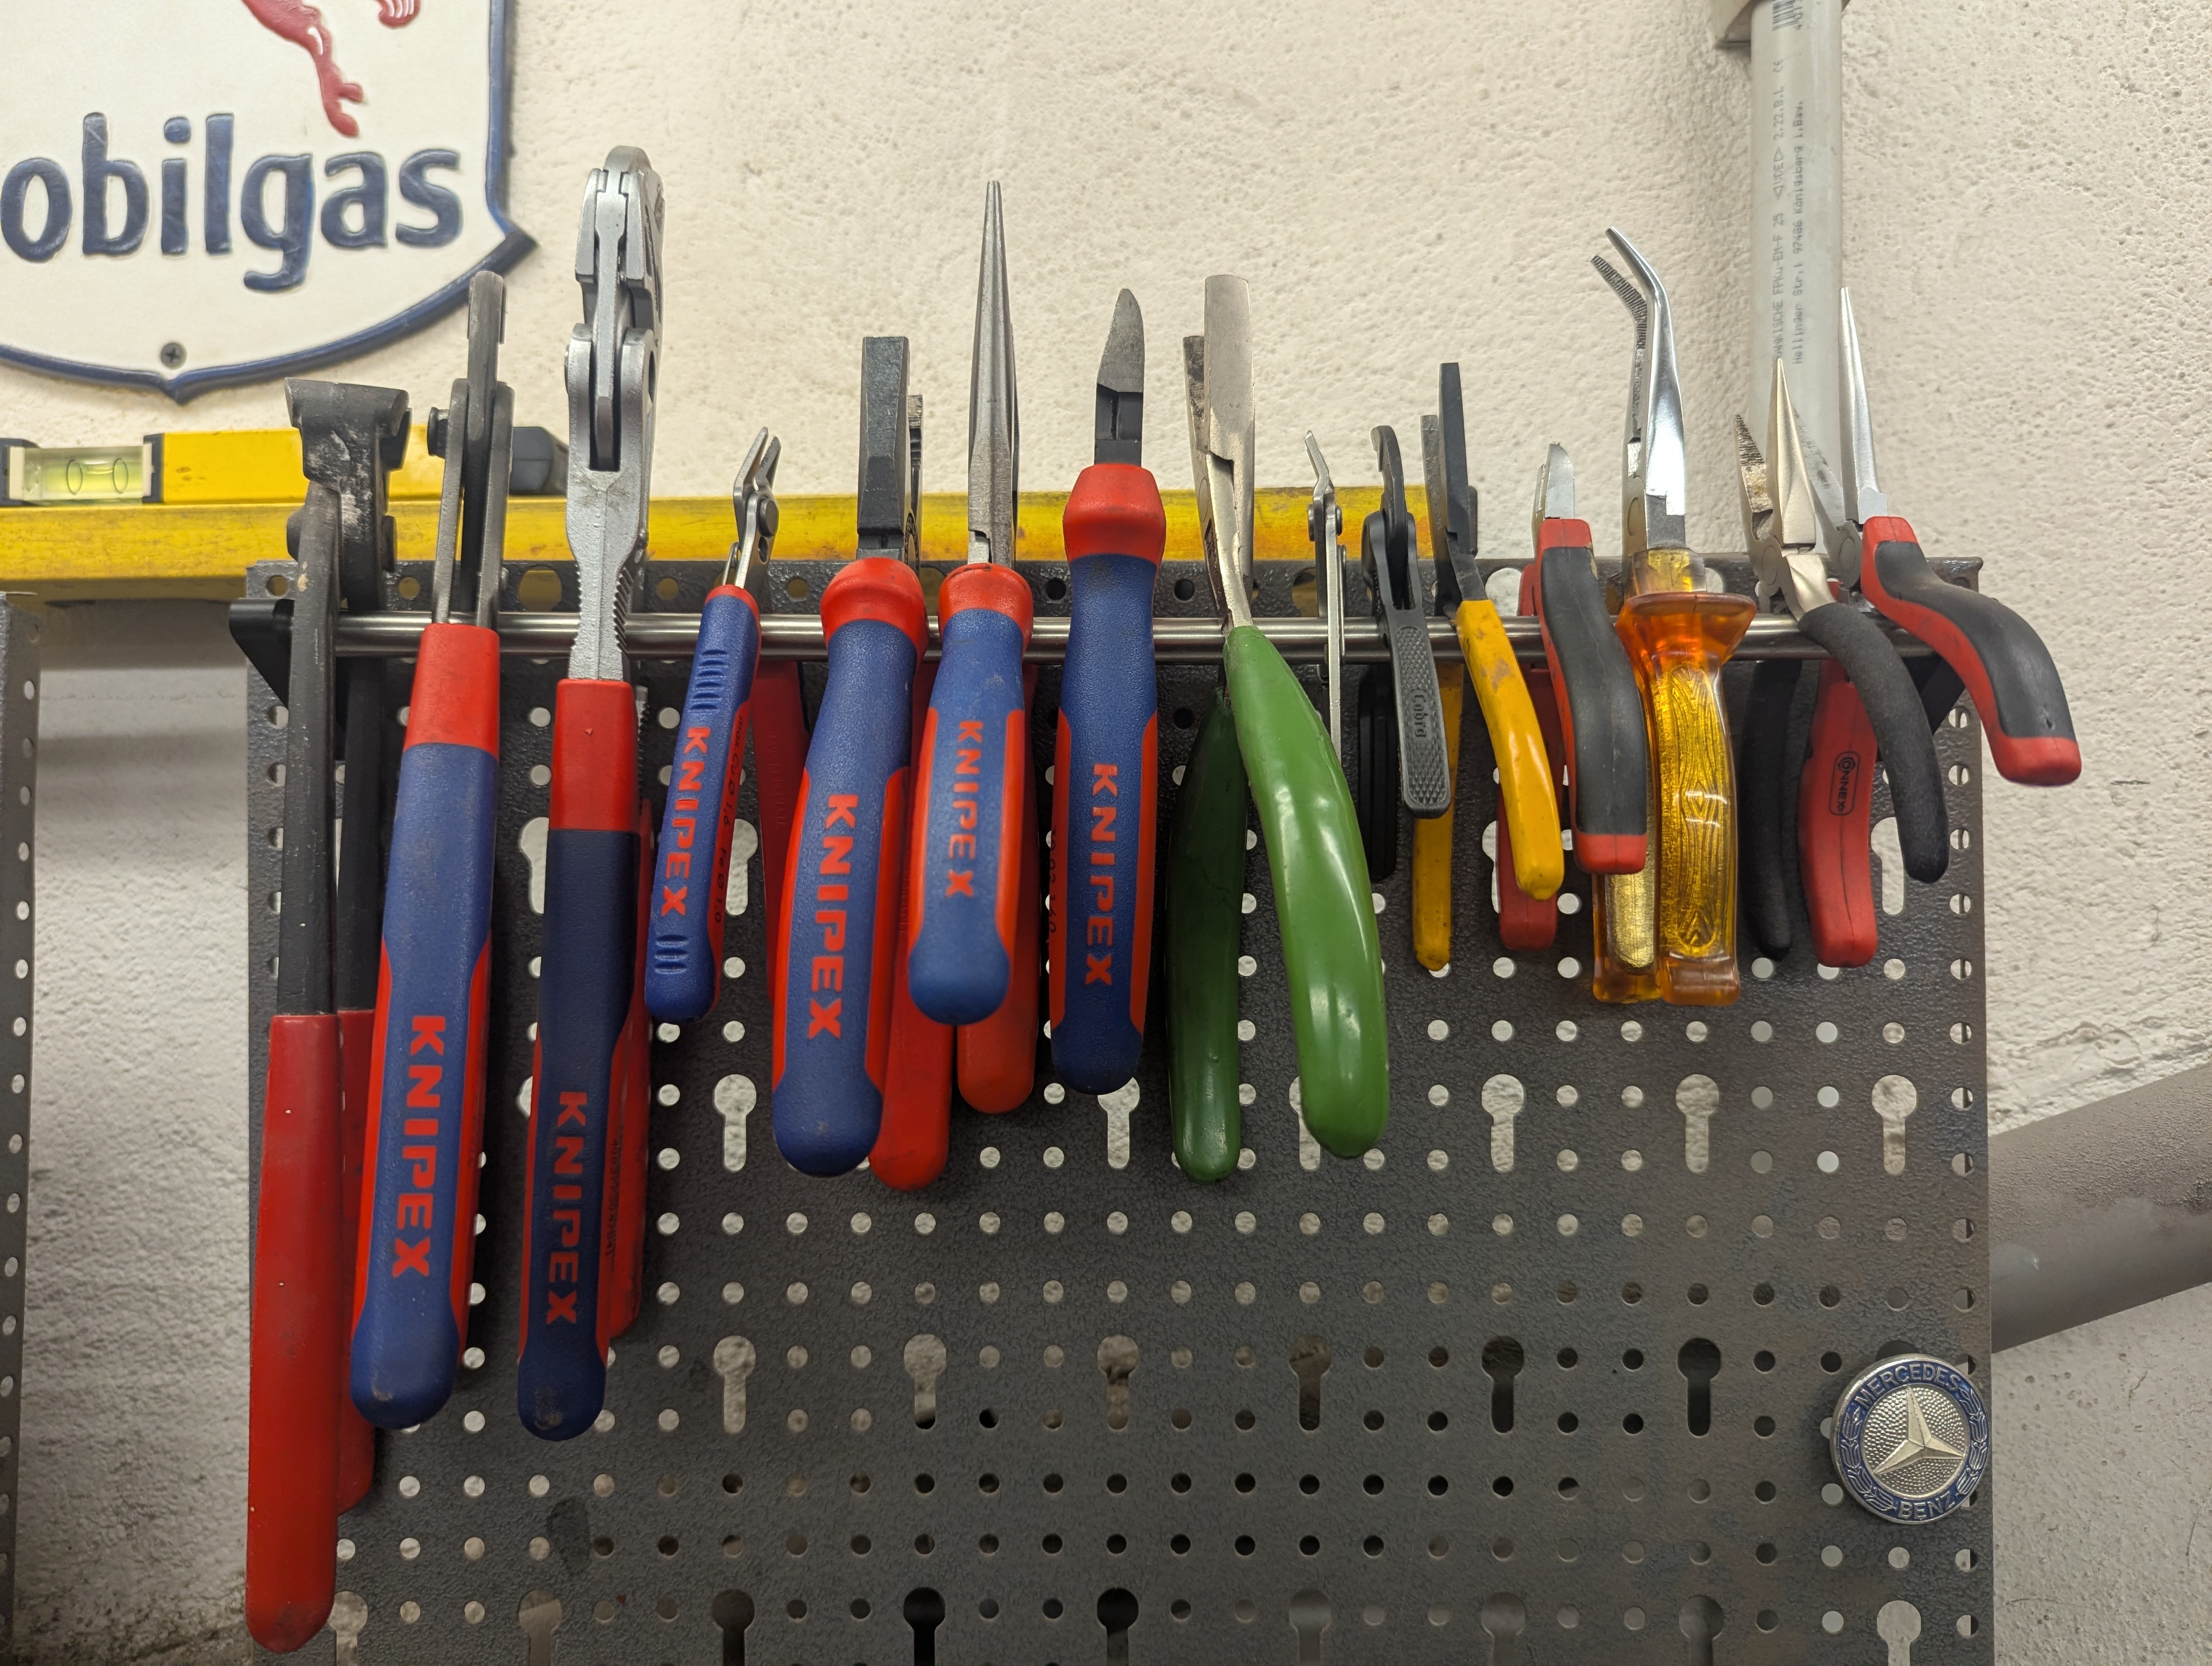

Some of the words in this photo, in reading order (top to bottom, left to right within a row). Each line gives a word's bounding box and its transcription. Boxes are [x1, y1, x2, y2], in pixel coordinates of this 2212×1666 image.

[1, 112, 464, 293] obilgas
[1791, 303, 1804, 364] Hellinger
[734, 716, 744, 750] max.
[1411, 694, 1429, 738] Cobra
[730, 753, 741, 775] Cu
[662, 727, 710, 915] KNIPEX
[947, 721, 982, 896] KNIPEX
[718, 848, 728, 868] Fe
[1086, 764, 1117, 984] KNIPEX
[713, 896, 724, 924] 1,0
[809, 794, 858, 1037] KNIPEX
[393, 1016, 445, 1276] KNIPEX
[547, 1093, 586, 1322] KNIPEX
[1855, 1363, 1961, 1409] MERCEDES
[1898, 1491, 1955, 1520] BENZ
